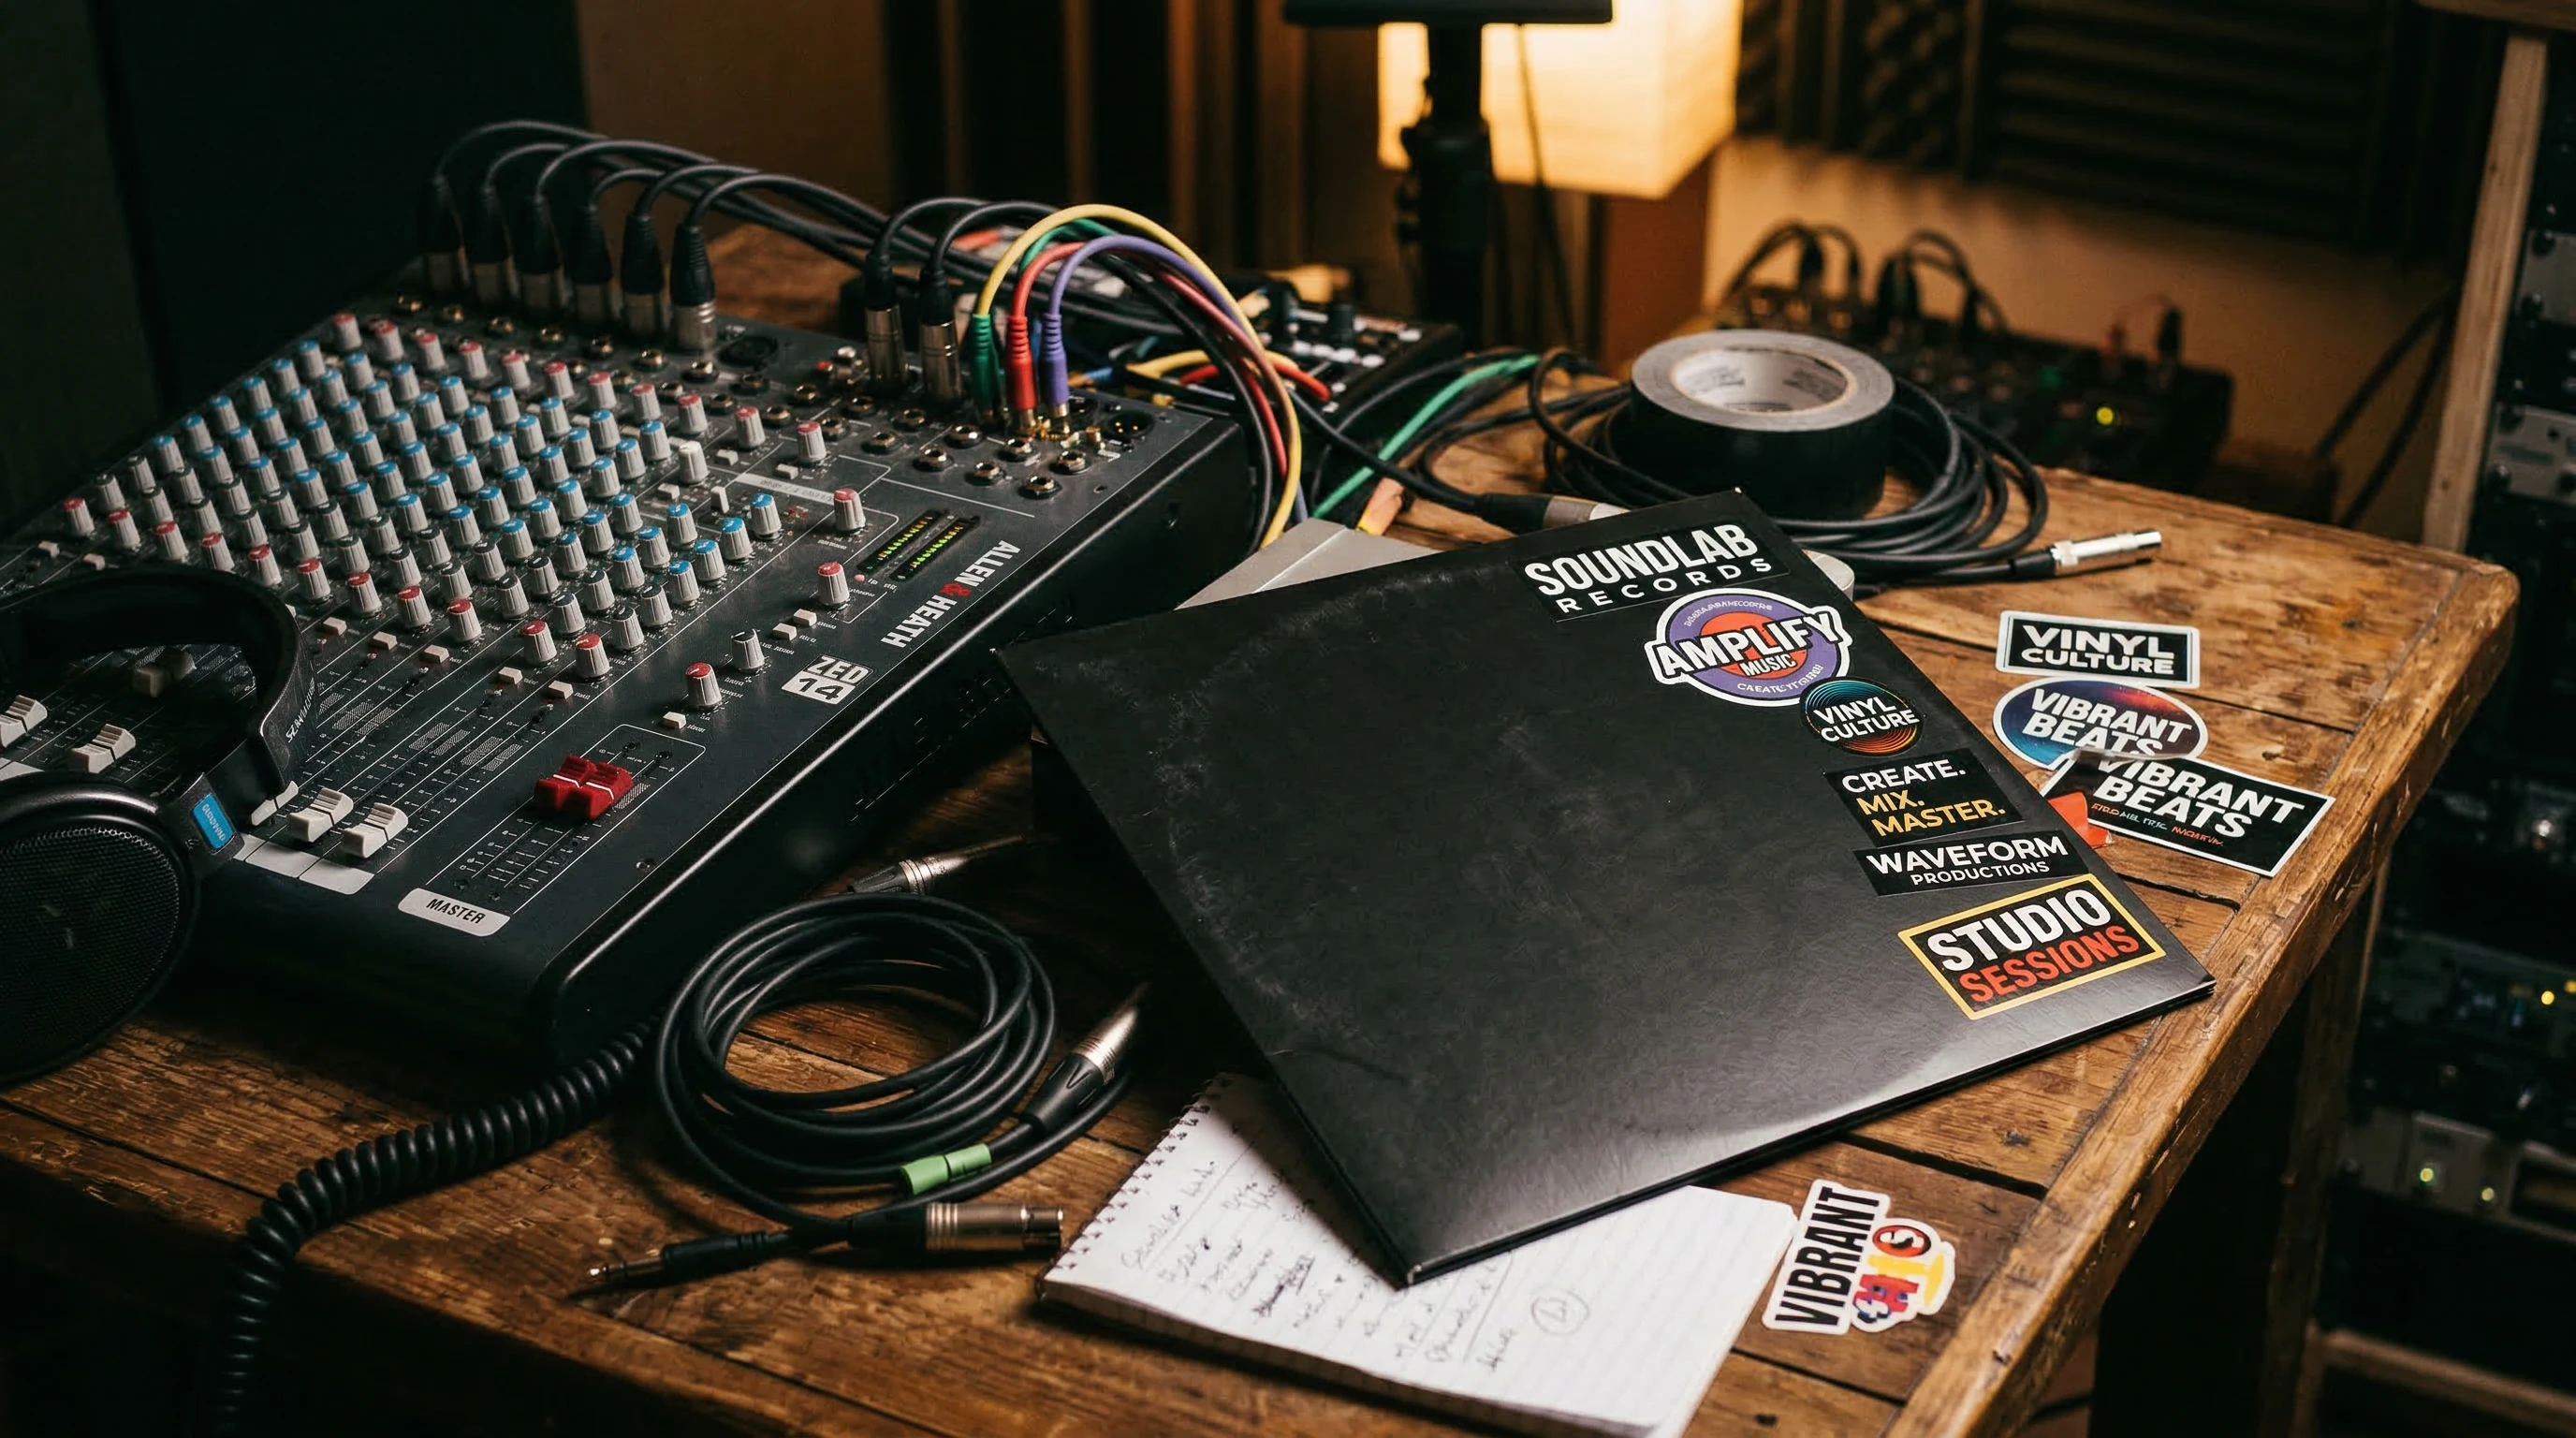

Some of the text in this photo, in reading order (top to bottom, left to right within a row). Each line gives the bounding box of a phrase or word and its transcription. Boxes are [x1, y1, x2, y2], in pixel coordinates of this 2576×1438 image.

[954, 539, 1020, 588] ALLEN
[1524, 524, 1758, 595] SOUNDLAB
[1556, 557, 1772, 614] RECORDS
[881, 594, 957, 648] HEATH
[1656, 613, 1839, 676] AMPLIFY
[2023, 624, 2174, 658] VINYL
[810, 656, 870, 685] ZED
[1740, 653, 1796, 677] MUSIC
[2020, 649, 2174, 675] CULTURE
[798, 677, 844, 700] 14
[1813, 697, 1896, 726] VINYL
[1821, 709, 1919, 743] CULTURE
[2030, 688, 2192, 743] VIBRANT
[2022, 713, 2163, 757] BEATS
[1842, 759, 1966, 794] CREATE.
[2097, 759, 2305, 823] VIBRANT
[1857, 790, 1925, 814] MIX.
[1871, 799, 2005, 837] MASTER.
[2093, 776, 2253, 838] BEATS
[1866, 835, 2068, 874] WAVEFORM
[1910, 861, 2050, 887] PRODUCTIONS
[427, 898, 486, 924] MASTER
[1927, 889, 2112, 971] STUDIO
[1959, 925, 2140, 1003] SESSIONS
[1775, 1186, 1880, 1326] VIBRANT
